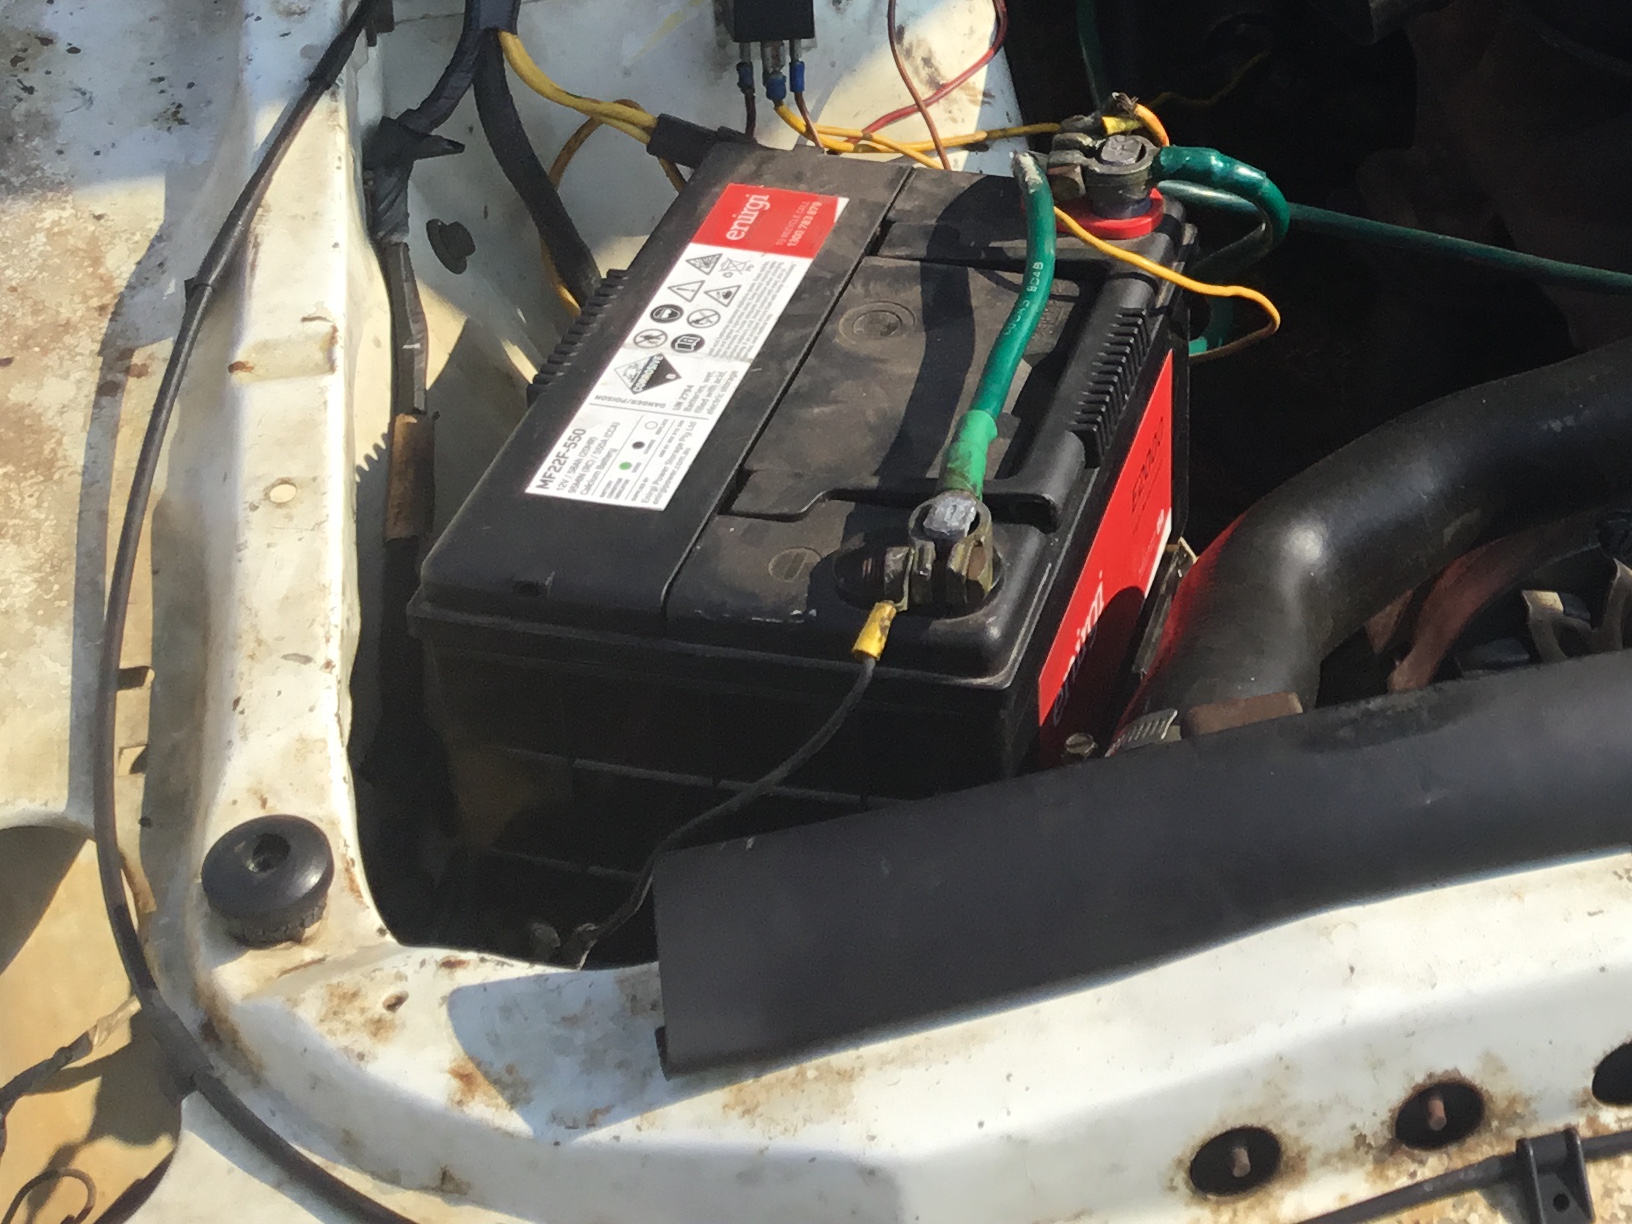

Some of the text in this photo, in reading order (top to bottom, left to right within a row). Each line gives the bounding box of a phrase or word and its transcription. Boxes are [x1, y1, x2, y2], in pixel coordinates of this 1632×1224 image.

[726, 194, 771, 240] enirgi
[631, 354, 664, 392] CORROSIVE
[594, 394, 667, 409] DANGER/POISON
[536, 428, 585, 489] MF22F-550
[556, 478, 569, 490] 12V
